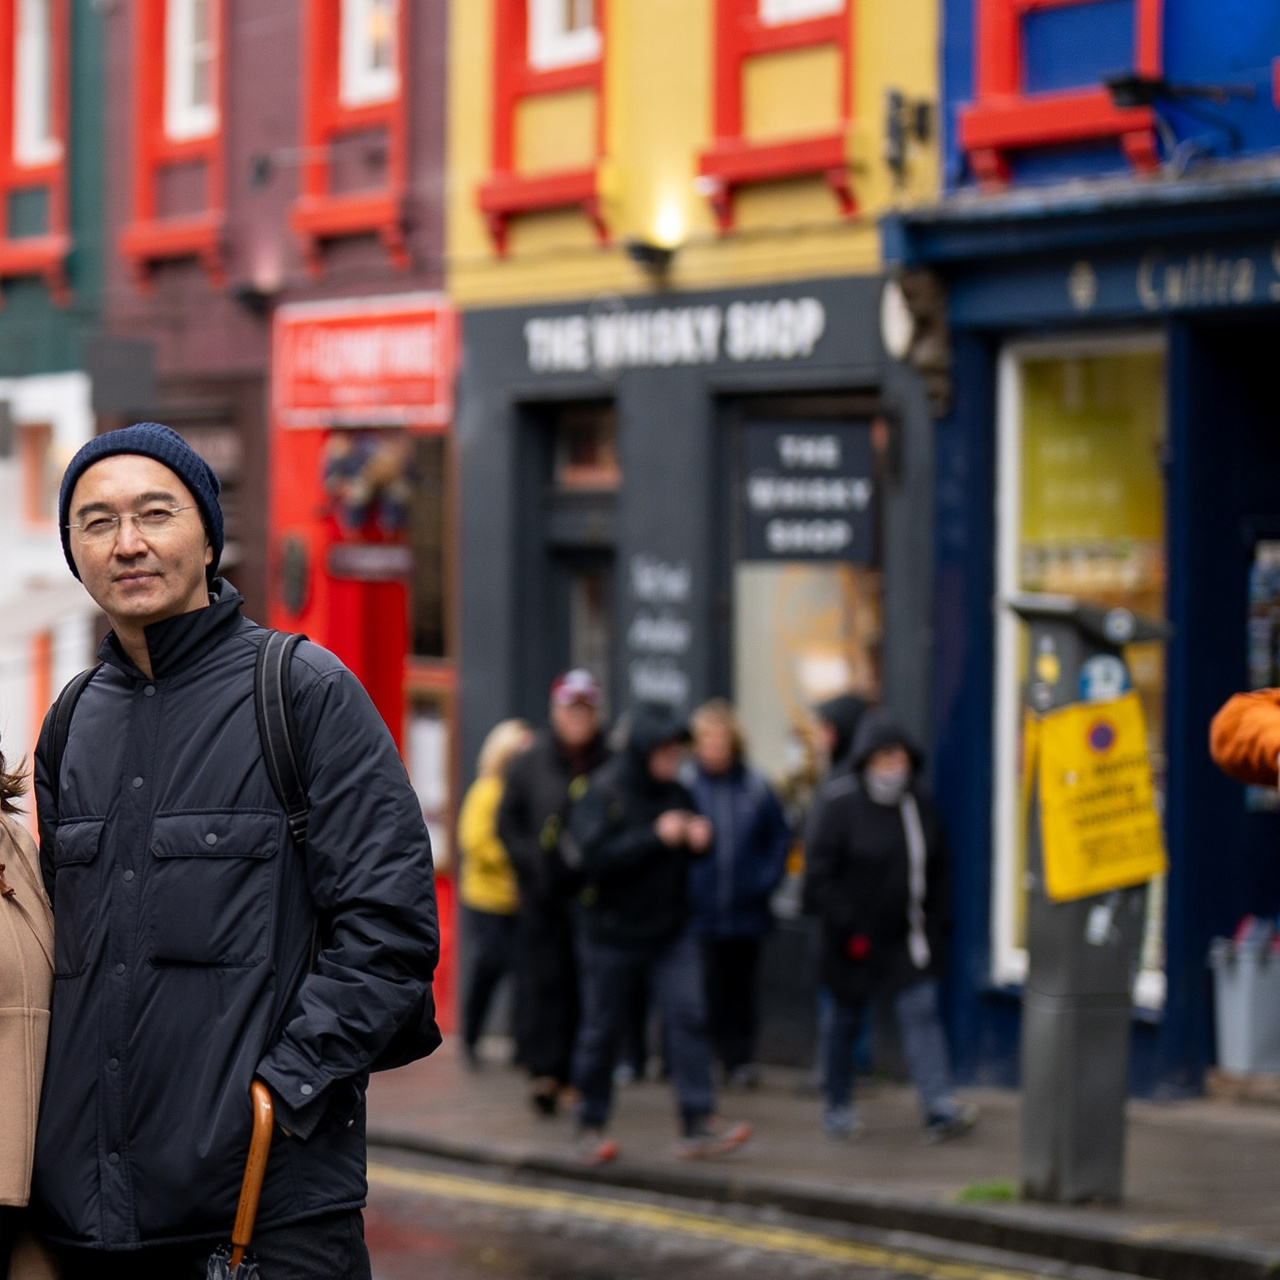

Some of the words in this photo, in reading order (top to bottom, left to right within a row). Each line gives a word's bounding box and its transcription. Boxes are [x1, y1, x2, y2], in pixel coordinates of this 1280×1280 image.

[525, 317, 589, 373] THE
[592, 307, 720, 368] WHISKY
[724, 298, 824, 361] SHOP
[779, 434, 840, 469] THE
[748, 477, 870, 512] WHISKY
[766, 519, 852, 553] SHOP
